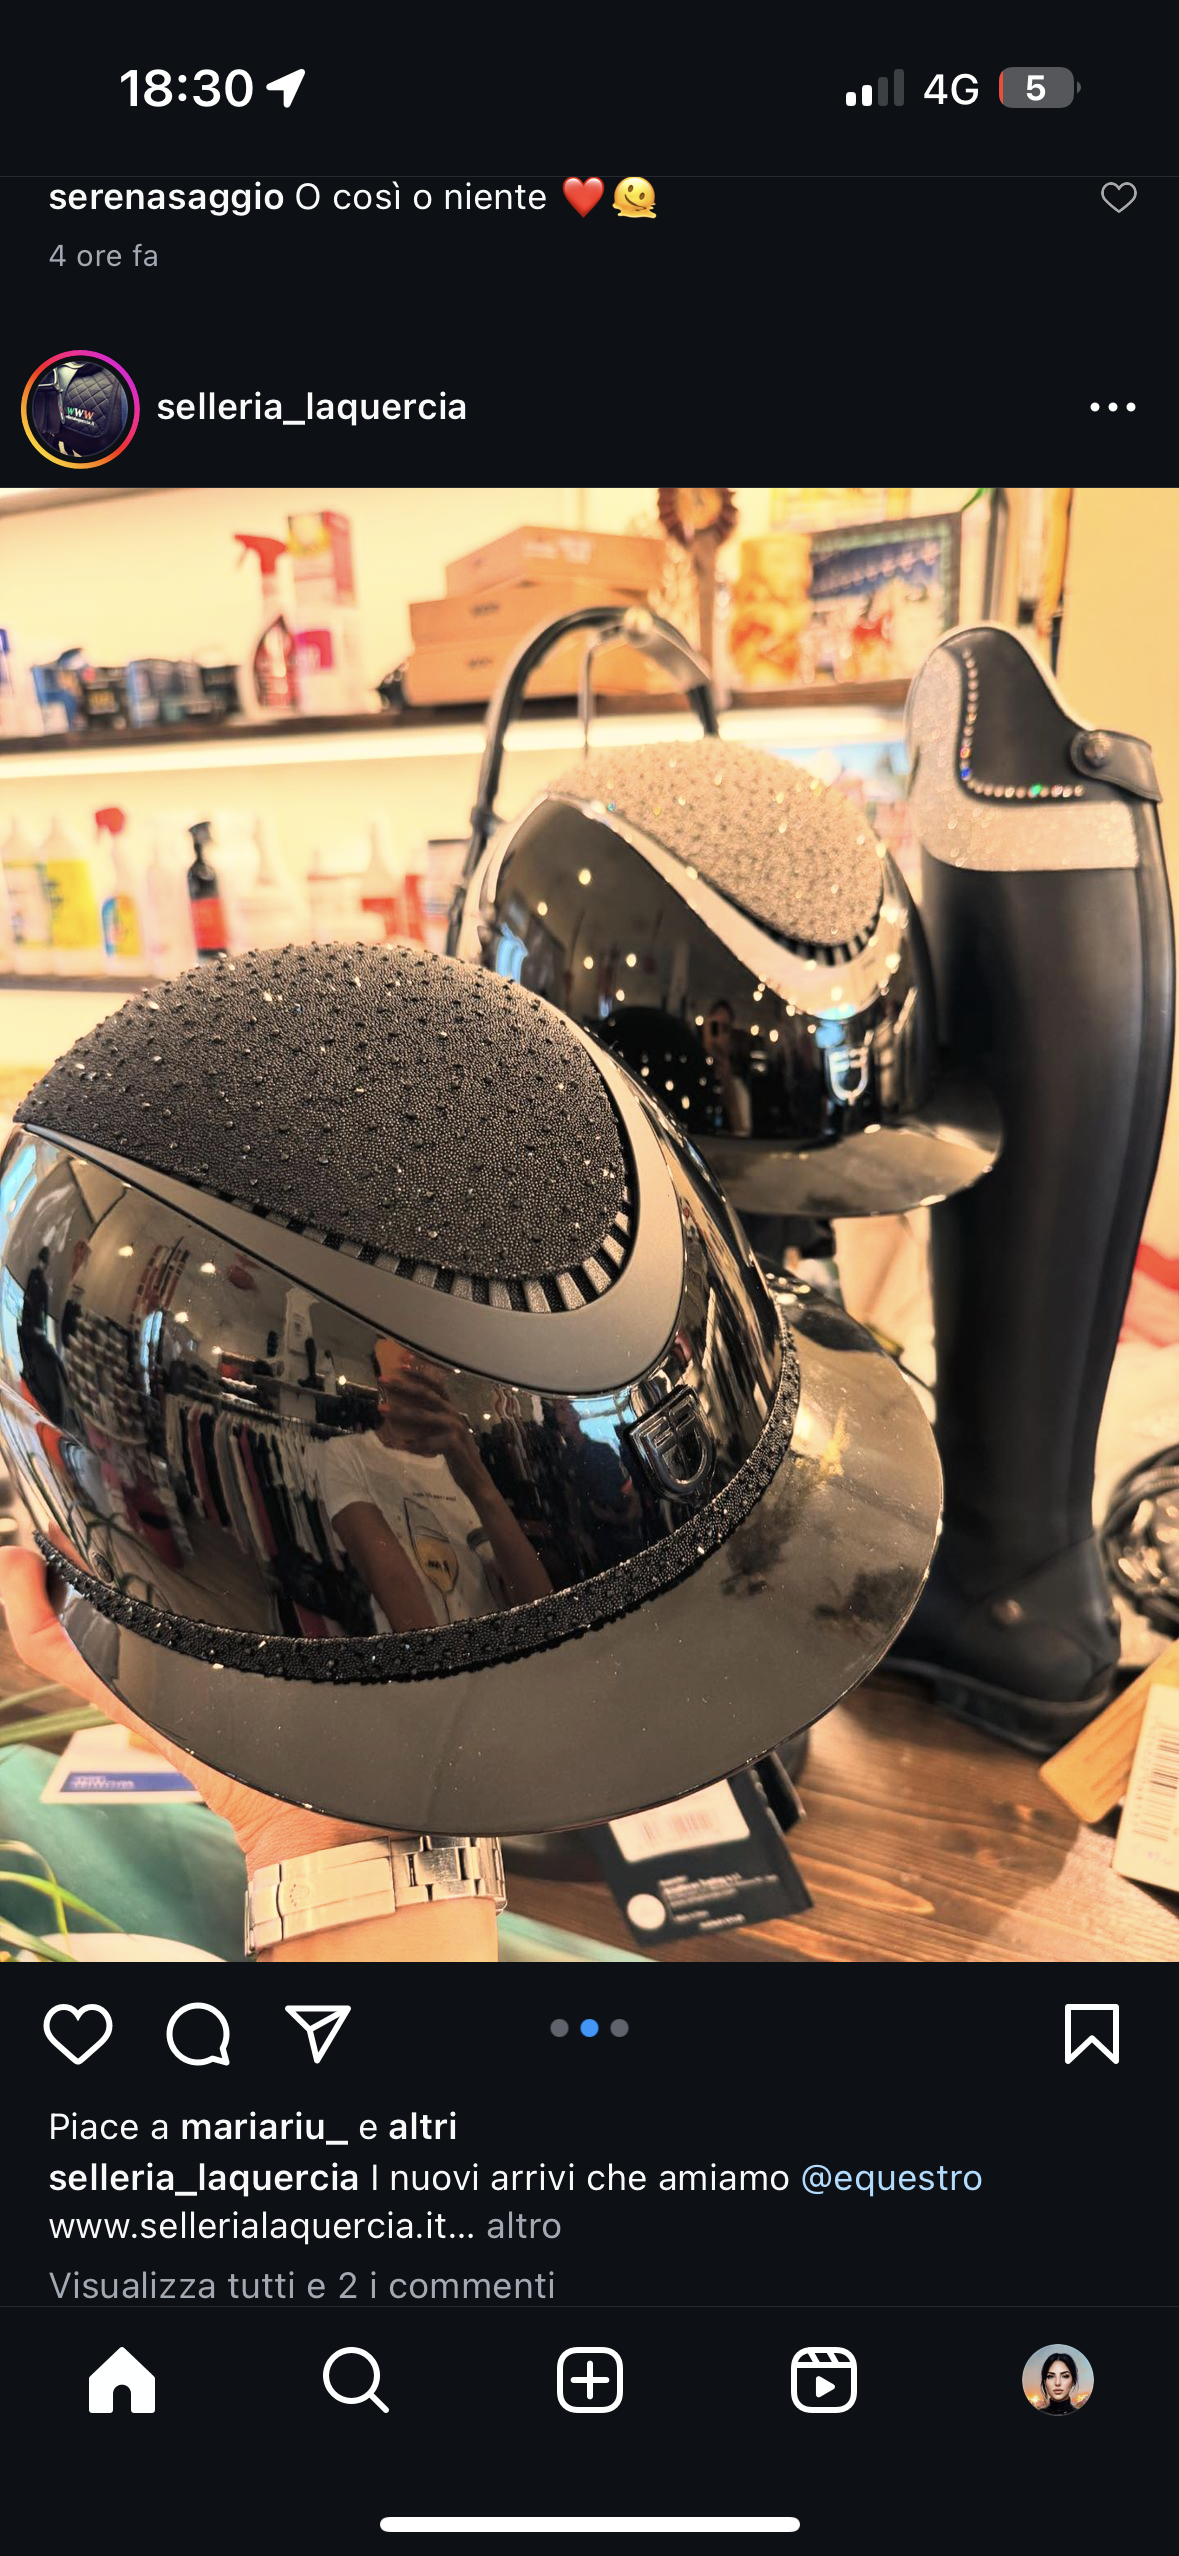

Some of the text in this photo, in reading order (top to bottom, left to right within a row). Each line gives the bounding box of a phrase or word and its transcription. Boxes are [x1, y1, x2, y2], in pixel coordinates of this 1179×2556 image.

[121, 69, 253, 107] 18:30
[924, 73, 978, 105] 4G
[1026, 75, 1046, 101] 5
[50, 181, 546, 216] serenasaggio O così o niente
[49, 244, 157, 266] 4 ore fa
[158, 391, 466, 426] selleria_laquercia
[51, 2111, 456, 2145] Piace a mariariu_ e altri
[50, 2162, 982, 2197] selleria_laquercia I nuovi arrivi che amiamo @equestro
[49, 2211, 561, 2245] www.sellerialaquercia.it... altro
[49, 2271, 554, 2299] Visualizza tutti e 2 i commenti
